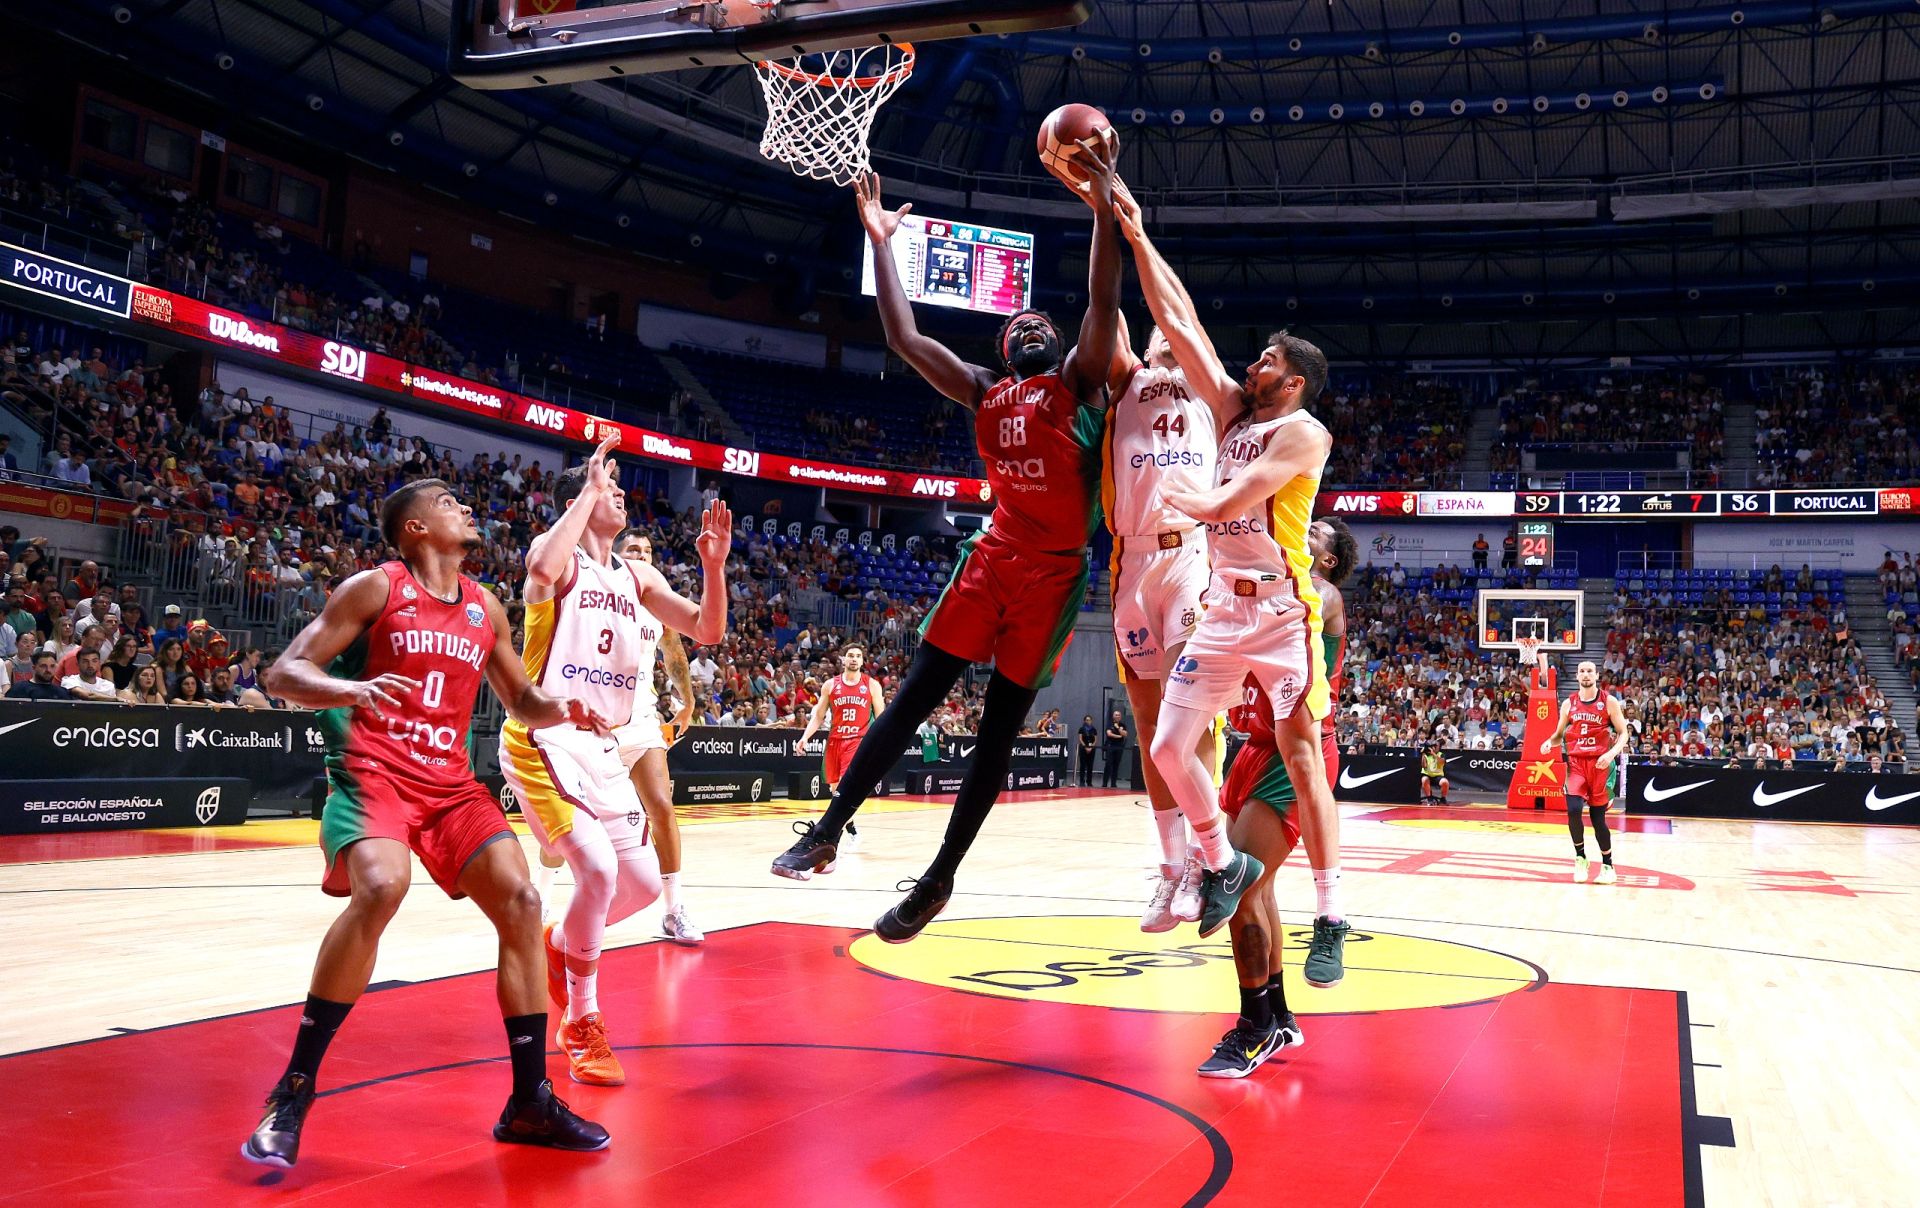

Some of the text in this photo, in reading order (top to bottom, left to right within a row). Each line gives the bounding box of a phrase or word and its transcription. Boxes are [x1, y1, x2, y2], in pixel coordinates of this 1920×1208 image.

[937, 254, 965, 270] 1:22
[13, 258, 117, 306] PORTUGAL
[928, 281, 936, 292] 4
[959, 286, 967, 296] 4
[134, 299, 172, 316] IMPERIUM
[135, 290, 172, 309] EUROPA
[133, 306, 171, 323] NOSTRUM
[208, 312, 280, 352] Wilson
[320, 341, 367, 379] SDI
[525, 403, 565, 431] AVIS
[999, 415, 1027, 448] 88
[1152, 413, 1185, 438] 44
[1130, 449, 1204, 468] endesa
[723, 447, 760, 474] SDI
[912, 478, 956, 497] AVIS
[1333, 495, 1378, 512] AVIS
[1436, 496, 1485, 511] ESPAÑA
[1577, 495, 1621, 513] 1:22
[1641, 502, 1673, 511] LOTUS
[1690, 494, 1703, 512] 7
[1793, 496, 1867, 510] PORTUGAL
[1880, 492, 1911, 500] EUROPA
[1523, 524, 1547, 534] 1:22
[1521, 537, 1548, 556] 24
[1823, 538, 1854, 546] CARPENA
[578, 589, 637, 622] ESPAÑA
[390, 629, 486, 672] PORTUGAL
[597, 628, 614, 655] 3
[561, 663, 637, 691] endesa
[422, 670, 446, 709] 0
[833, 695, 868, 708] PORTUGAL
[842, 708, 857, 721] 28
[53, 722, 160, 748] endesa
[209, 728, 283, 748] CaixaBank
[1580, 723, 1589, 735] 2
[692, 737, 733, 754] endesa
[752, 741, 783, 755] CaixaBank
[410, 751, 448, 767] seguros
[716, 782, 741, 791] ESPAÑOLA
[1517, 786, 1564, 798] CaixaBank
[23, 796, 163, 812] SELECCIÓN ESPAÑOLA
[41, 811, 146, 824] DE BALONCESTO
